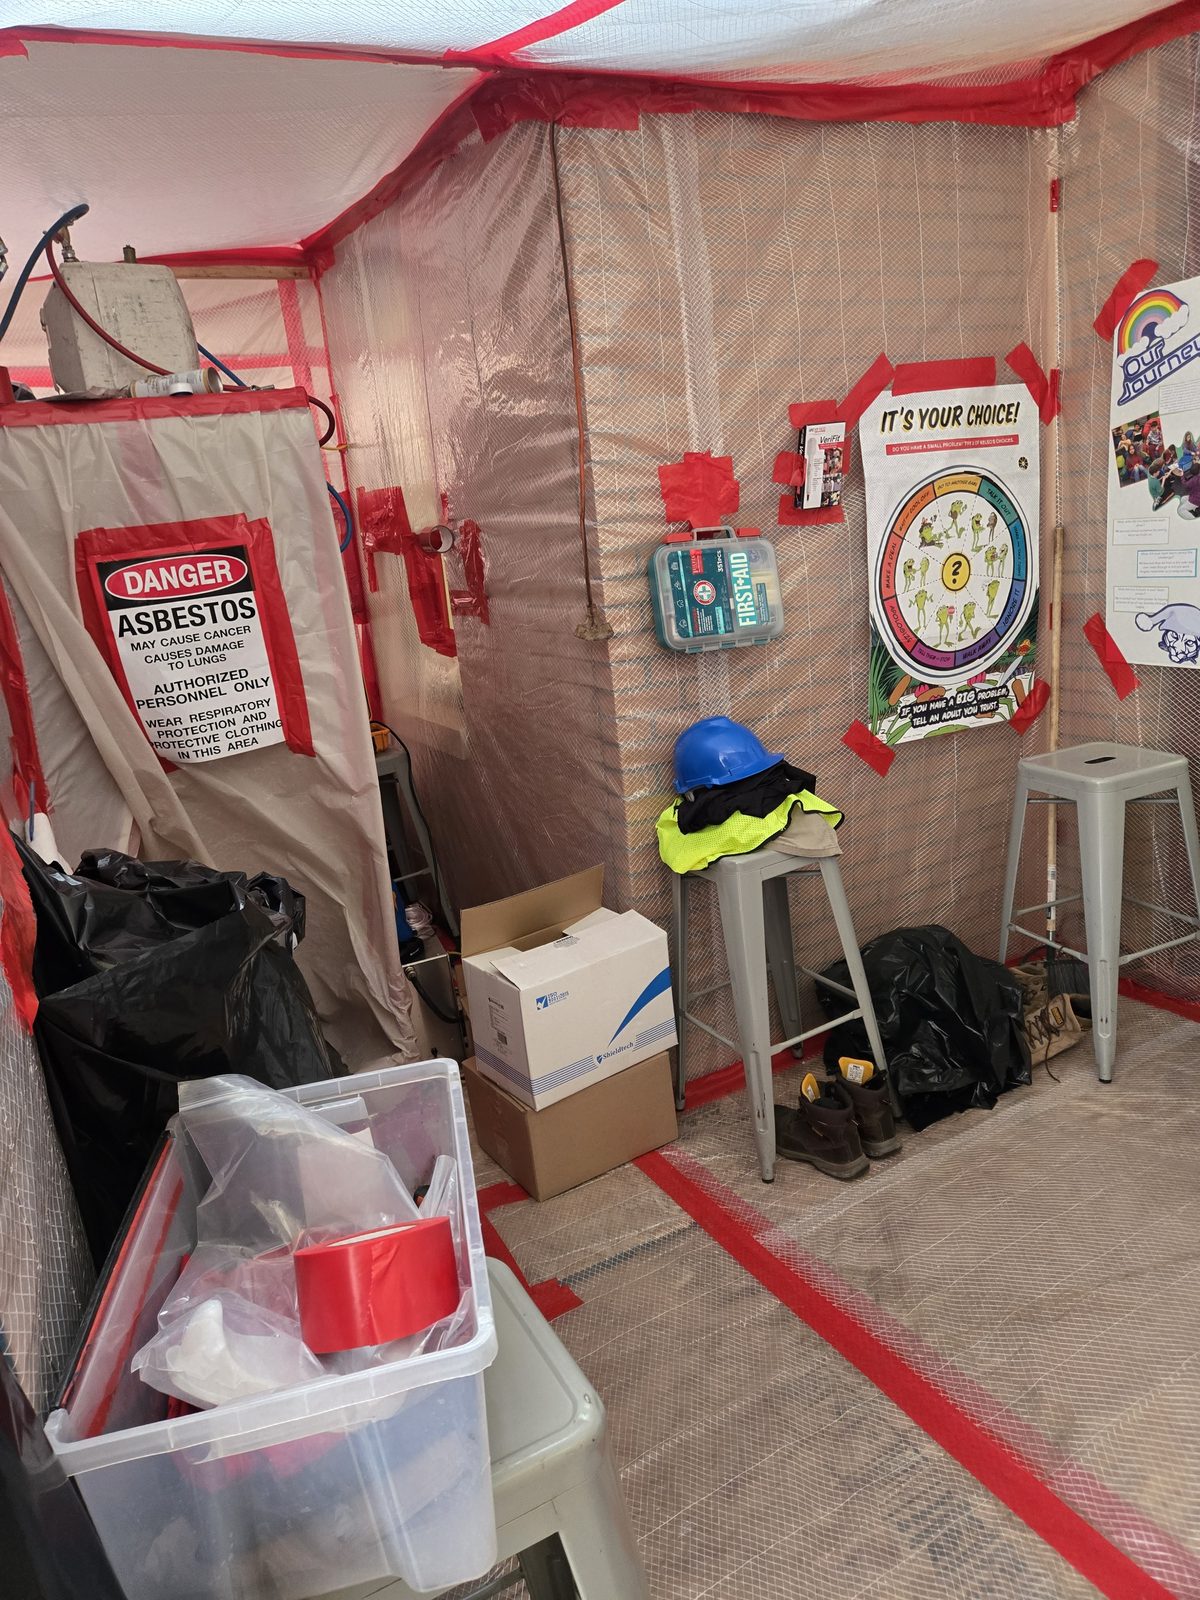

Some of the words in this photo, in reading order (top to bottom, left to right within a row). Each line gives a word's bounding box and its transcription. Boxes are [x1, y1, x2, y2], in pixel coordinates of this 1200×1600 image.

[1125, 341, 1165, 377] Our
[881, 407, 914, 433] IT'S
[919, 405, 963, 430] YOUR
[967, 402, 1021, 428] CHOICE!
[820, 434, 841, 443] VeriFit
[986, 488, 998, 500] TALK
[1001, 504, 1011, 516] OUT
[123, 560, 233, 595] DANGER
[730, 552, 750, 579] AID
[951, 560, 962, 584] ?
[118, 597, 256, 638] ASBESTOS
[733, 583, 757, 627] FIRST
[1003, 599, 1018, 627] IGNORE
[890, 605, 914, 643] APOLOGIZE
[131, 640, 156, 652] MAY
[160, 633, 201, 647] CAUSE
[204, 625, 252, 640] CANCER
[144, 649, 192, 664] CAUSES
[196, 640, 245, 656] DAMAGE
[168, 661, 184, 671] TO
[187, 654, 227, 668] LUNGS
[136, 687, 227, 709] PERSONNEL
[234, 677, 270, 692] ONLY
[154, 668, 249, 695] AUTHORIZED
[146, 716, 183, 728] WEAR
[189, 698, 271, 723] RESPIRATORY
[901, 706, 911, 717] IF
[913, 704, 928, 714] YOU
[929, 699, 946, 711] HAVE
[948, 698, 954, 706] A
[956, 691, 976, 704] BIG
[912, 717, 927, 727] TELL
[929, 713, 940, 723] AN
[942, 709, 962, 721] ADULT
[964, 707, 978, 716] YOU
[157, 718, 236, 739] PROTECTION
[242, 711, 267, 724] AND
[225, 719, 283, 739] CLOTHING
[178, 750, 190, 760] IN
[192, 745, 221, 759] THIS
[227, 737, 259, 751] AREA
[603, 1041, 634, 1059] Shieldtech
